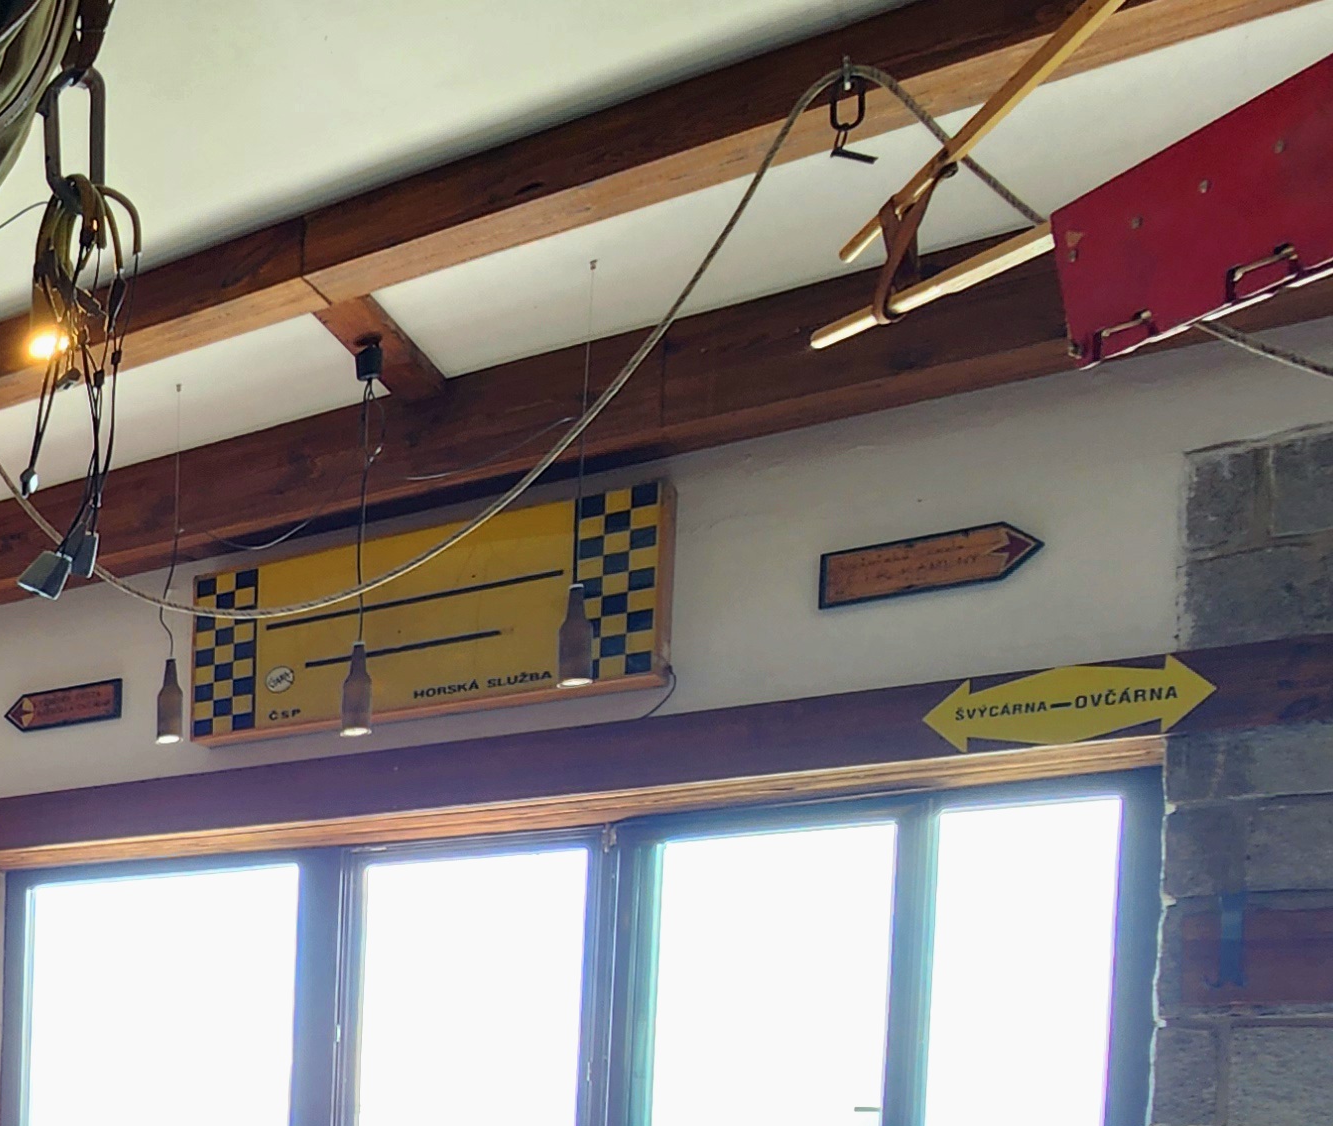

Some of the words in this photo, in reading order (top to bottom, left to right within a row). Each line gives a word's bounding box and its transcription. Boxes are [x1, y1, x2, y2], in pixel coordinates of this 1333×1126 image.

[413, 679, 480, 699] HORSKÁ
[486, 669, 553, 688] SLUŽBA
[269, 709, 301, 721] ČSP
[955, 701, 1047, 721] ŠVÝCÁRNA
[1074, 686, 1178, 709] OVČÁRNA
